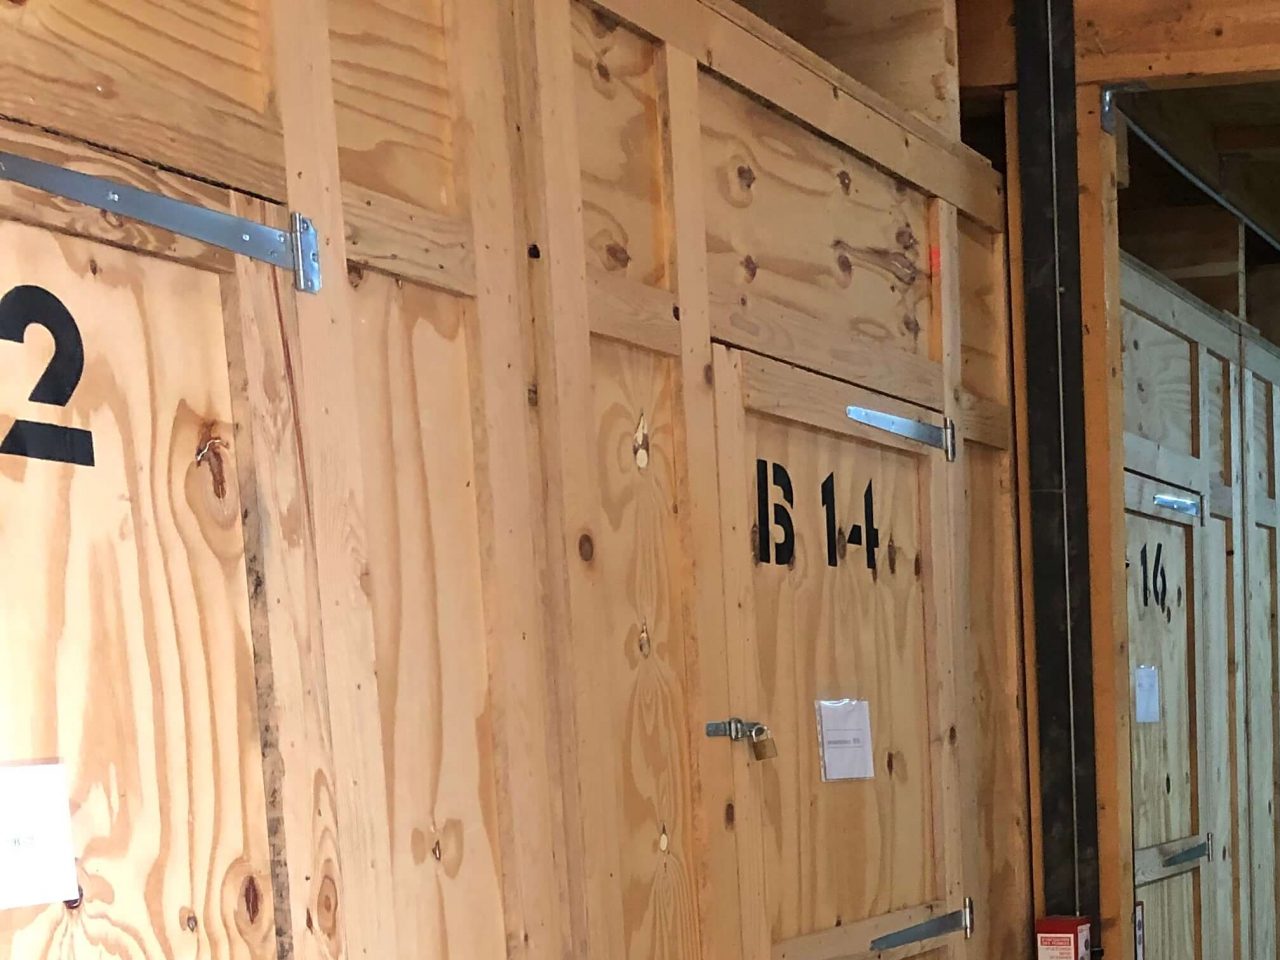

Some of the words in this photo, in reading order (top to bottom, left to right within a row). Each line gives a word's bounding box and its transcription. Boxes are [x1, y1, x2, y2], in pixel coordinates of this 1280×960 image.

[0, 285, 95, 466] 2
[757, 459, 795, 565] B
[821, 472, 879, 569] 14
[1140, 542, 1167, 607] 16
